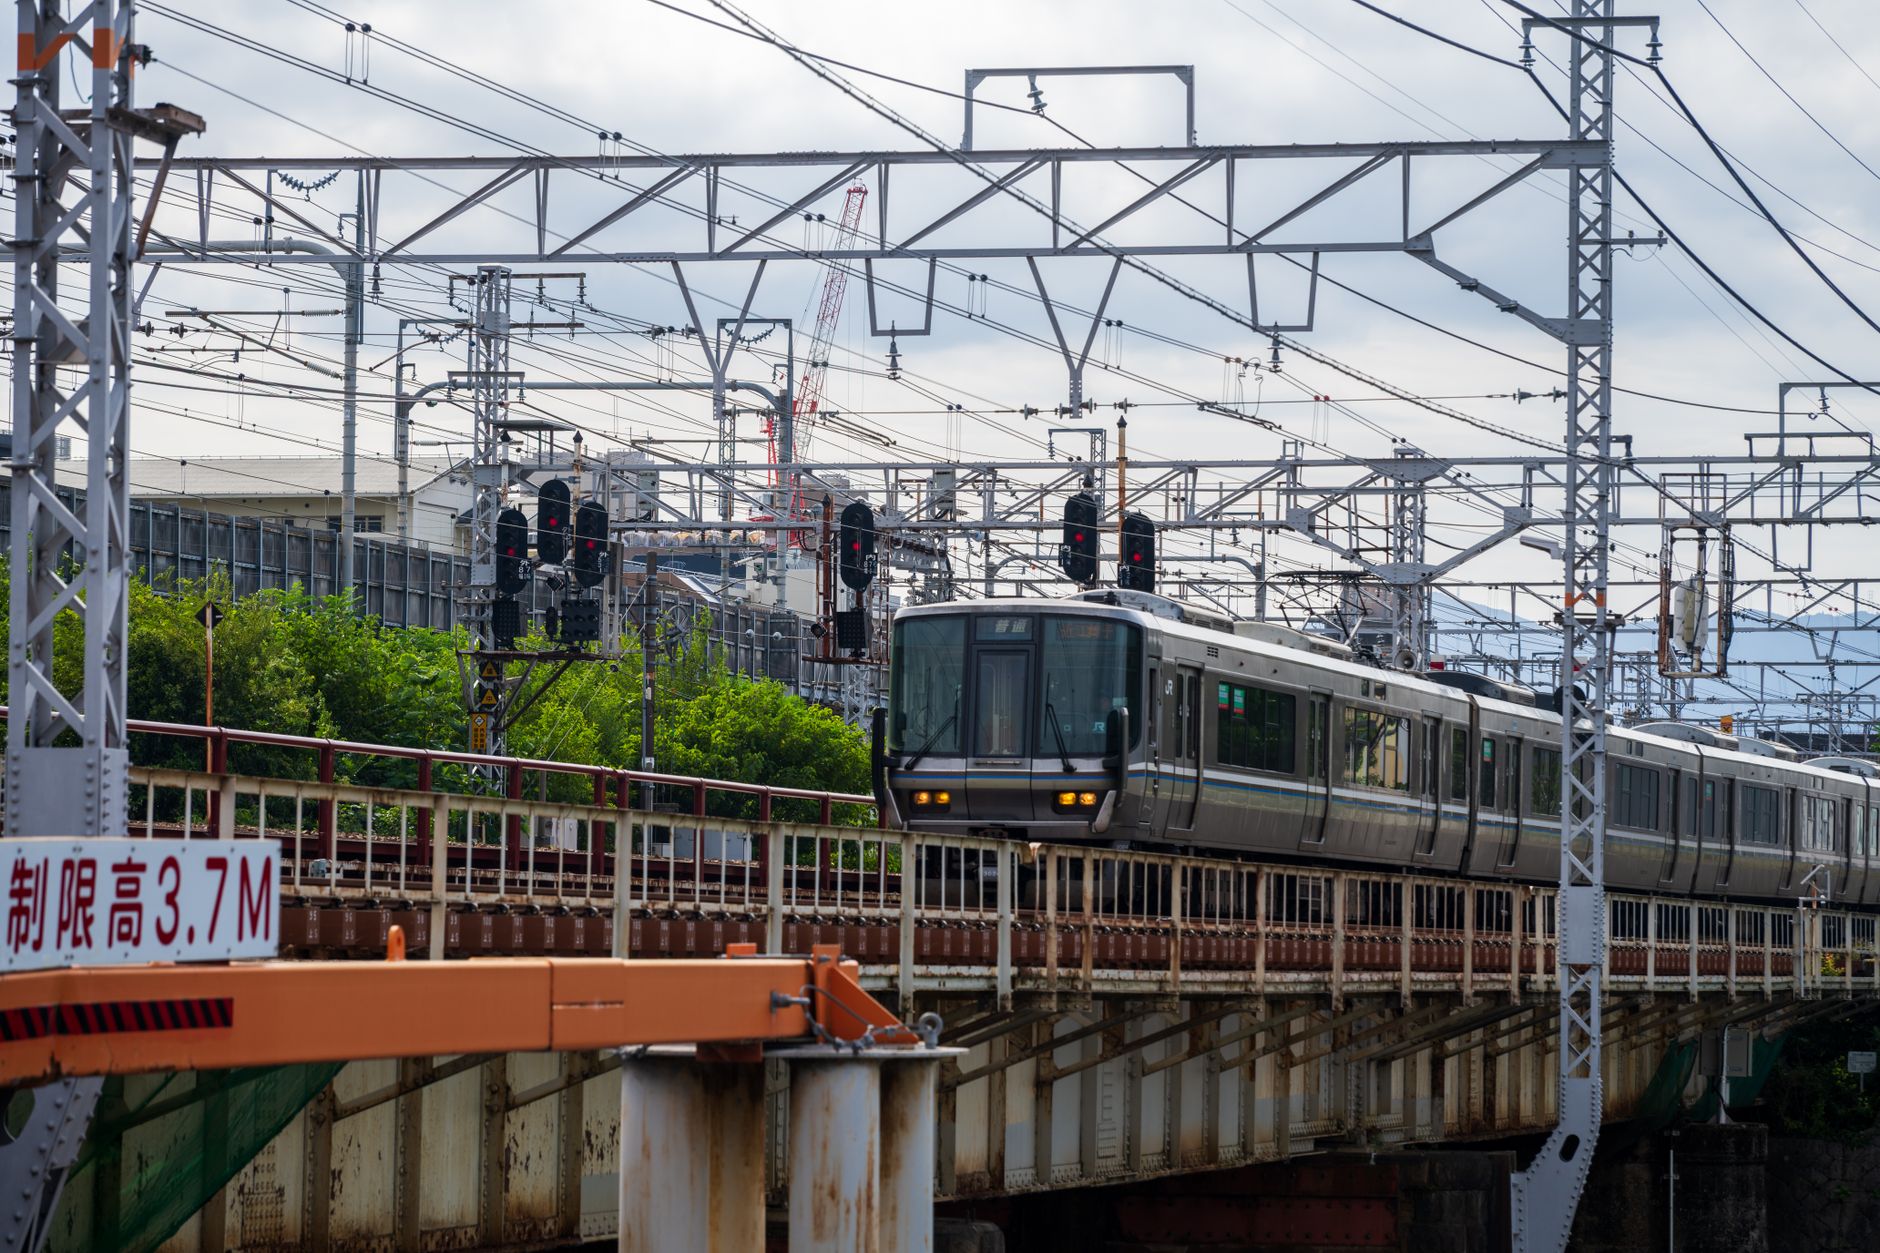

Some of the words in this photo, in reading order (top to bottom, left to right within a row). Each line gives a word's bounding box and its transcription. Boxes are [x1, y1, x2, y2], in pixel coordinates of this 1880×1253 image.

[995, 619, 1027, 633] 普通
[1165, 679, 1173, 695] JR
[1092, 721, 1105, 731] JR
[7, 855, 272, 954] 制限高3.7M
